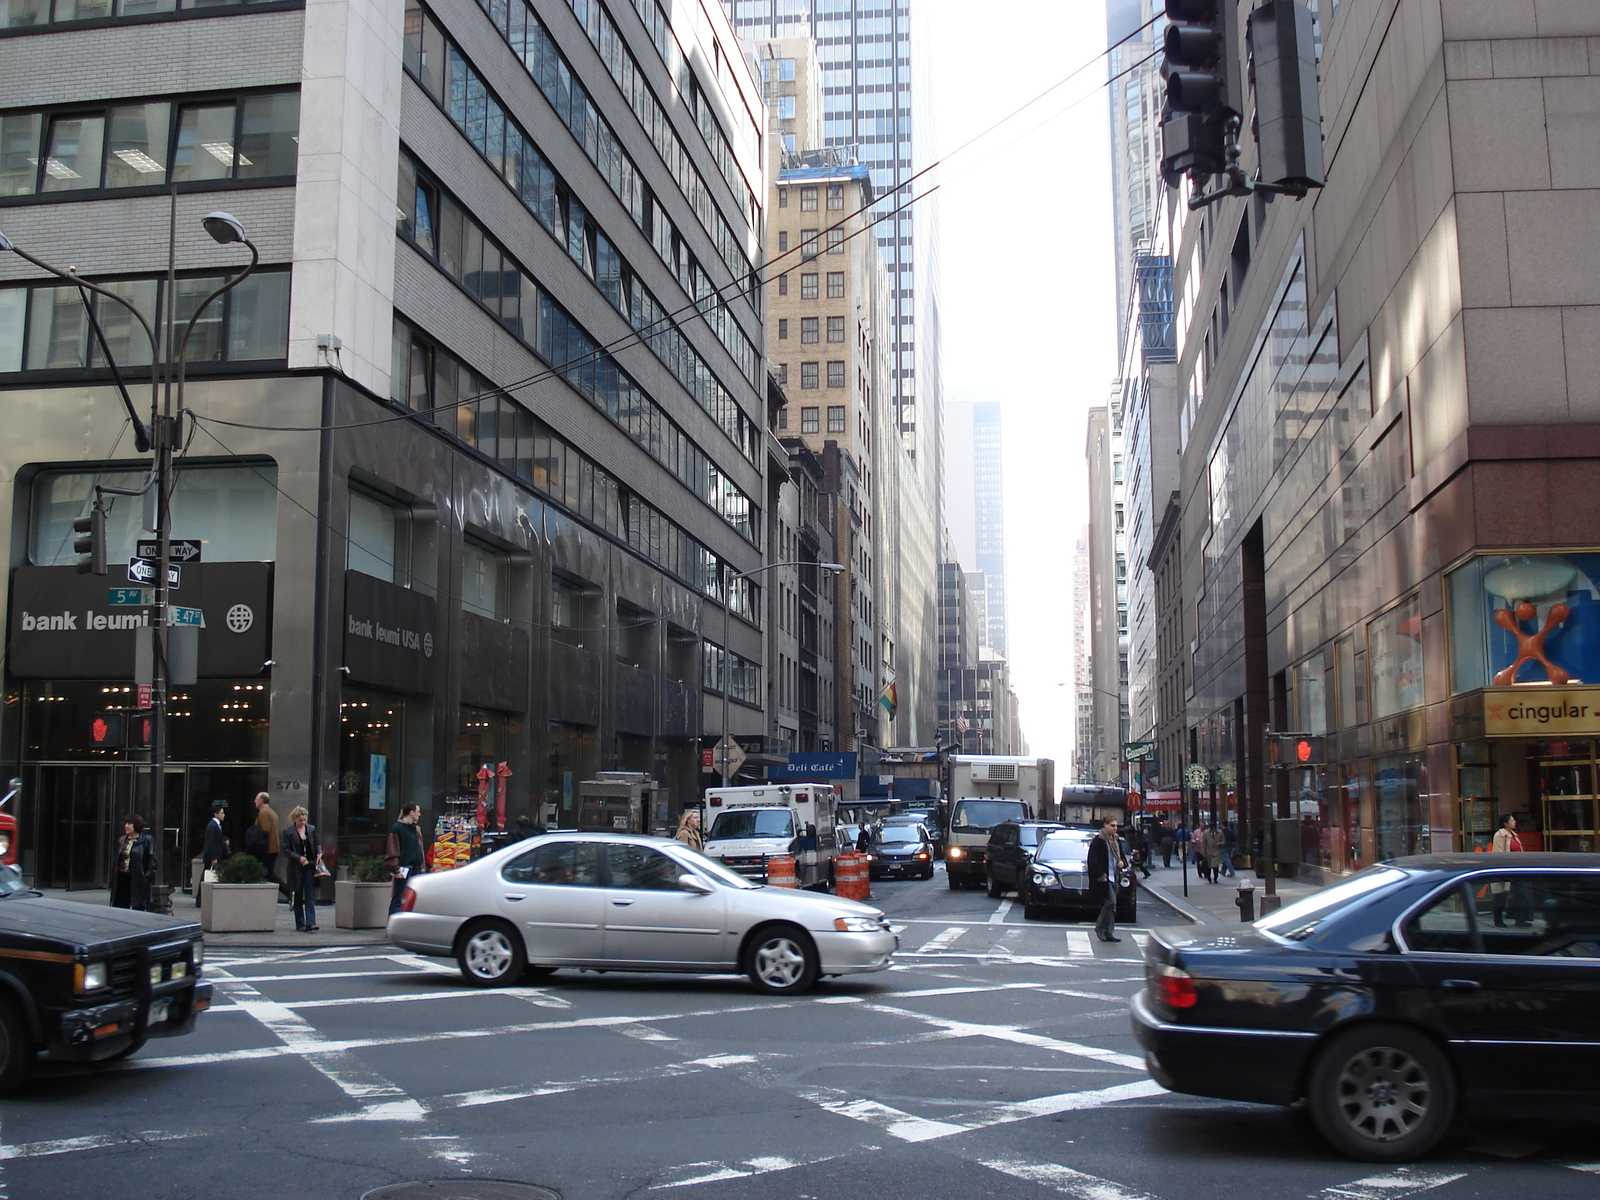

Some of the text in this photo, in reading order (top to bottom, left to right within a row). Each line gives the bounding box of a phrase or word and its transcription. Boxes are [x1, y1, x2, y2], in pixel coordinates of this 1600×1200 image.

[145, 546, 194, 556] ON WAY
[136, 565, 152, 577] ONE
[117, 590, 138, 604] 5 AV
[22, 610, 149, 631] bank leumi
[183, 610, 194, 623] 47
[348, 614, 420, 651] bank leumi USA
[1508, 700, 1589, 723] cingular
[787, 762, 834, 772] Deli Café
[276, 781, 300, 790] 579
